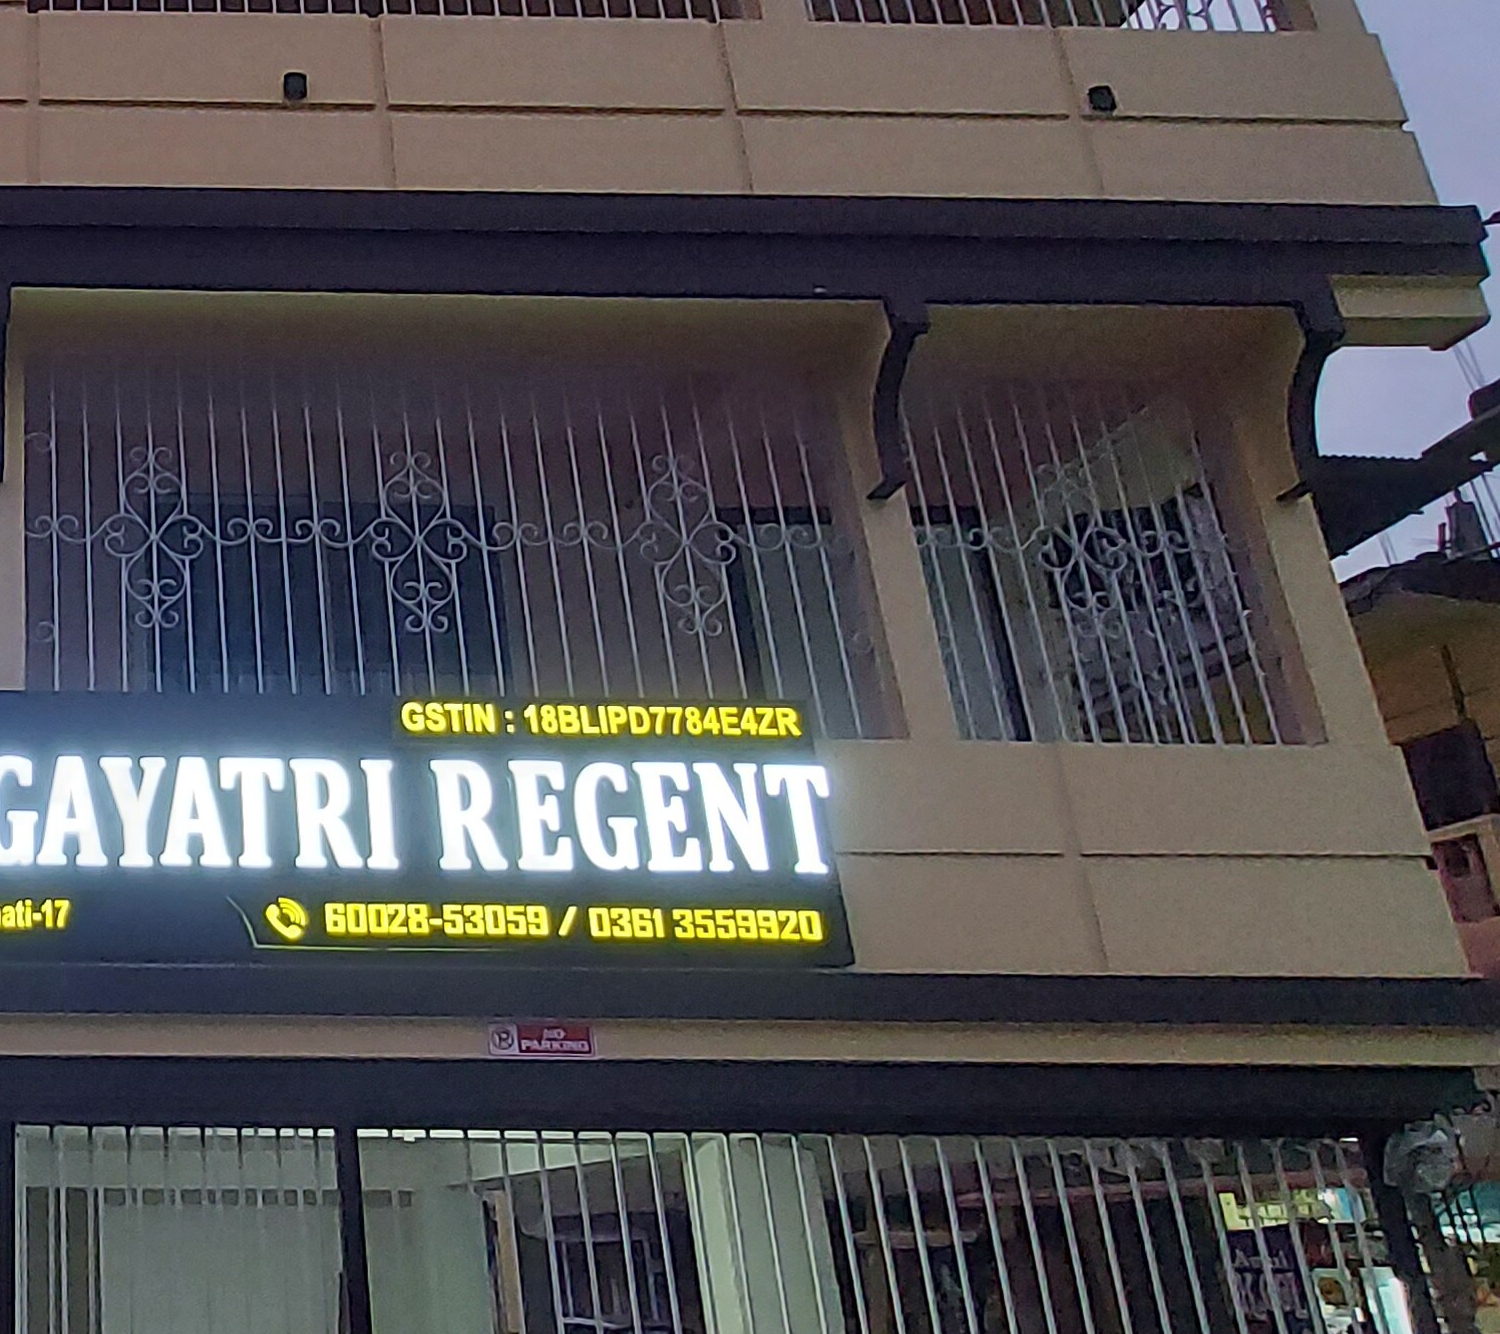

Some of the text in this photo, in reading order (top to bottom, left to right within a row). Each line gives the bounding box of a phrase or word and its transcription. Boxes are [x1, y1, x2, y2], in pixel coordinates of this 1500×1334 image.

[400, 702, 495, 734] GSTIN
[523, 704, 802, 737] 18BLIPD7784E4ZR
[430, 759, 831, 874] REGENT
[324, 902, 549, 936] 60028-53059
[589, 907, 666, 939] 0361
[671, 908, 824, 941] 3559920
